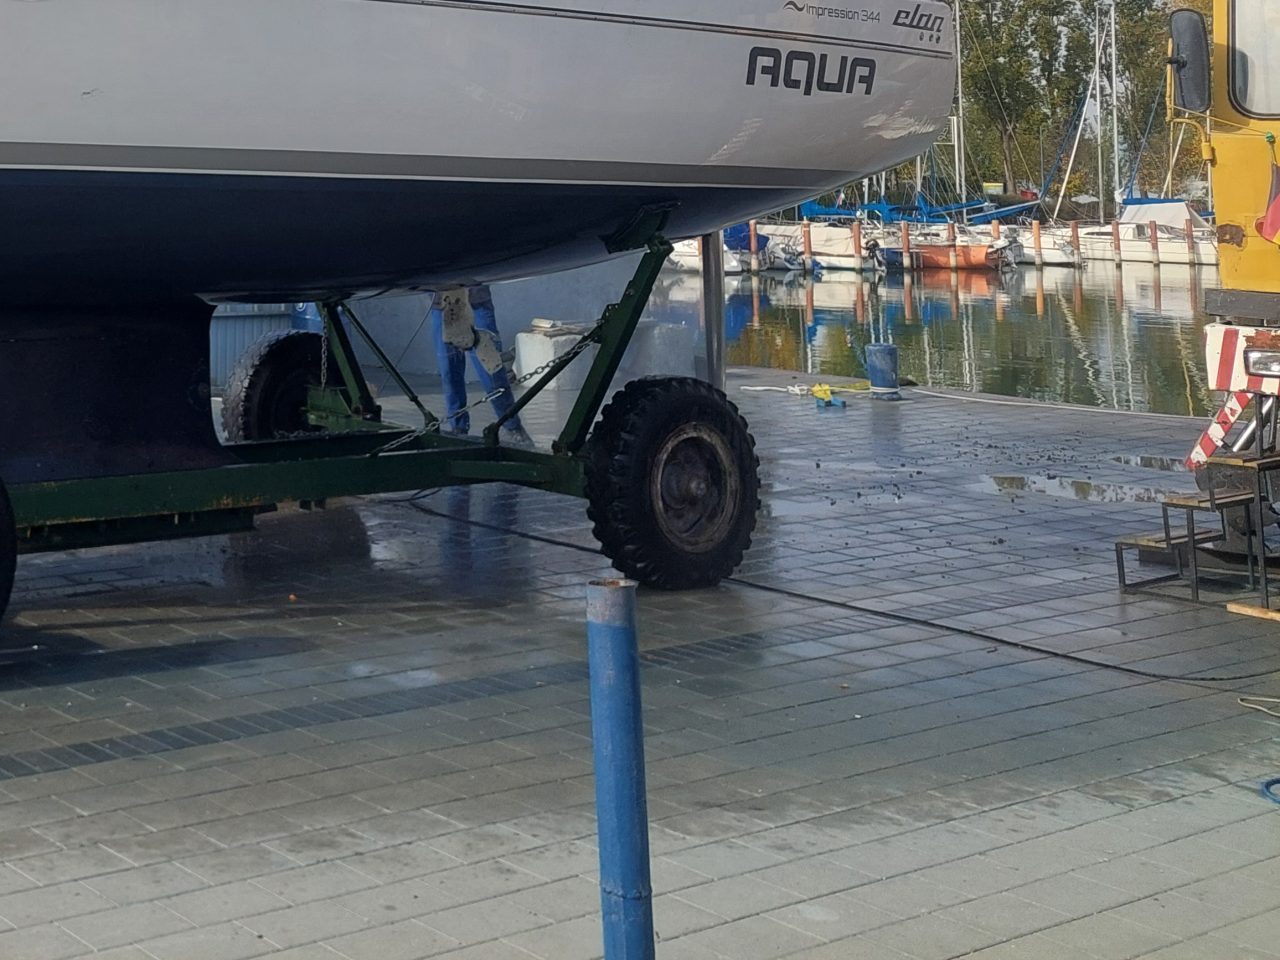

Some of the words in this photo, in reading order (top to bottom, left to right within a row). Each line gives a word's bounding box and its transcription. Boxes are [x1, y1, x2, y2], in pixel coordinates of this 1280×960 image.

[806, 2, 859, 21] Impression
[860, 9, 881, 23] 344
[892, 3, 944, 33] elan
[745, 46, 877, 96] AQUA
